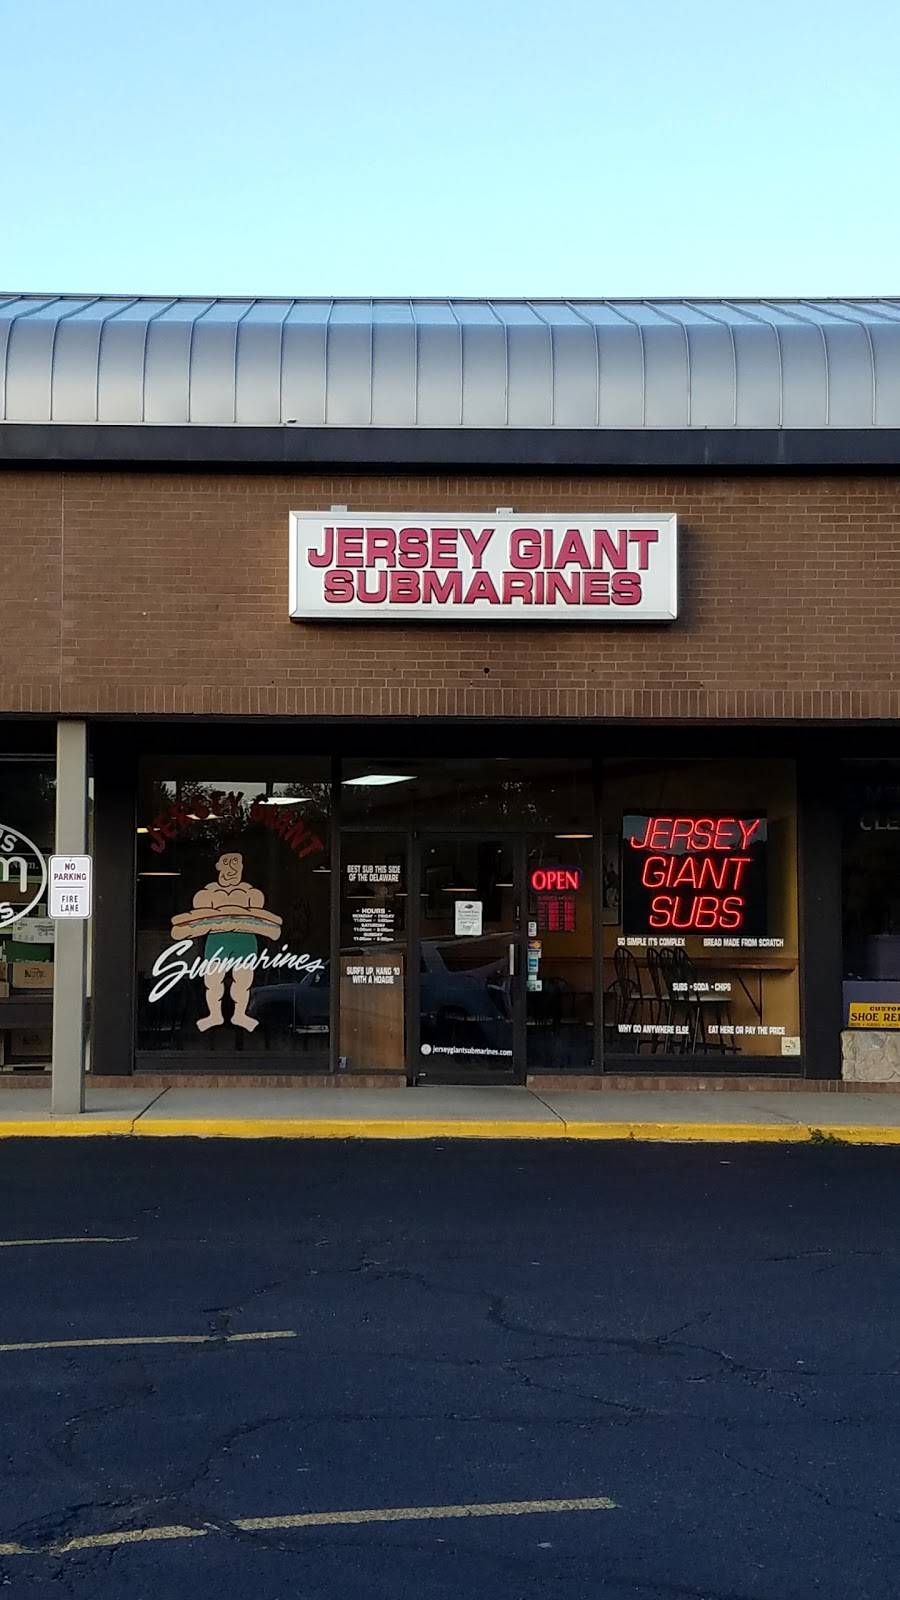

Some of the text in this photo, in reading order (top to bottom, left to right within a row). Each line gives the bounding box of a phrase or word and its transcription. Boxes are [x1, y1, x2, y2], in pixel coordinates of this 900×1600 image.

[307, 527, 659, 570] JERSEY GIANT
[323, 569, 643, 605] SUBMARINES
[630, 817, 760, 850] JERSEY
[64, 863, 76, 871] NO
[347, 864, 401, 874] BEST SUB THIS SIDE
[53, 872, 87, 881] PARKING
[348, 873, 400, 883] OF THE DELAWARE
[642, 856, 753, 890] GIANT
[531, 870, 579, 891] OPEN
[61, 895, 79, 903] FIRE
[60, 904, 80, 912] LANE
[649, 896, 745, 928] SUBS
[617, 937, 626, 946] SO
[626, 937, 647, 946] SIMPLE
[658, 937, 686, 947] COMPLEX
[703, 938, 784, 948] BREAD MADE FROM SCRATCH
[148, 939, 326, 1003] Submarines
[375, 966, 392, 976] HANG
[392, 967, 401, 976] 10
[352, 975, 395, 985] WITH A HOAGIE
[672, 982, 732, 992] SUBS SODA CHIPS
[851, 1012, 879, 1022] SHOE
[618, 1024, 689, 1035] WHY GO ANYWHERE ELSE
[707, 1025, 786, 1036] EAT HERE OR PAY THE PRICE
[432, 1044, 513, 1057] jerseygiantsubmarines.com
